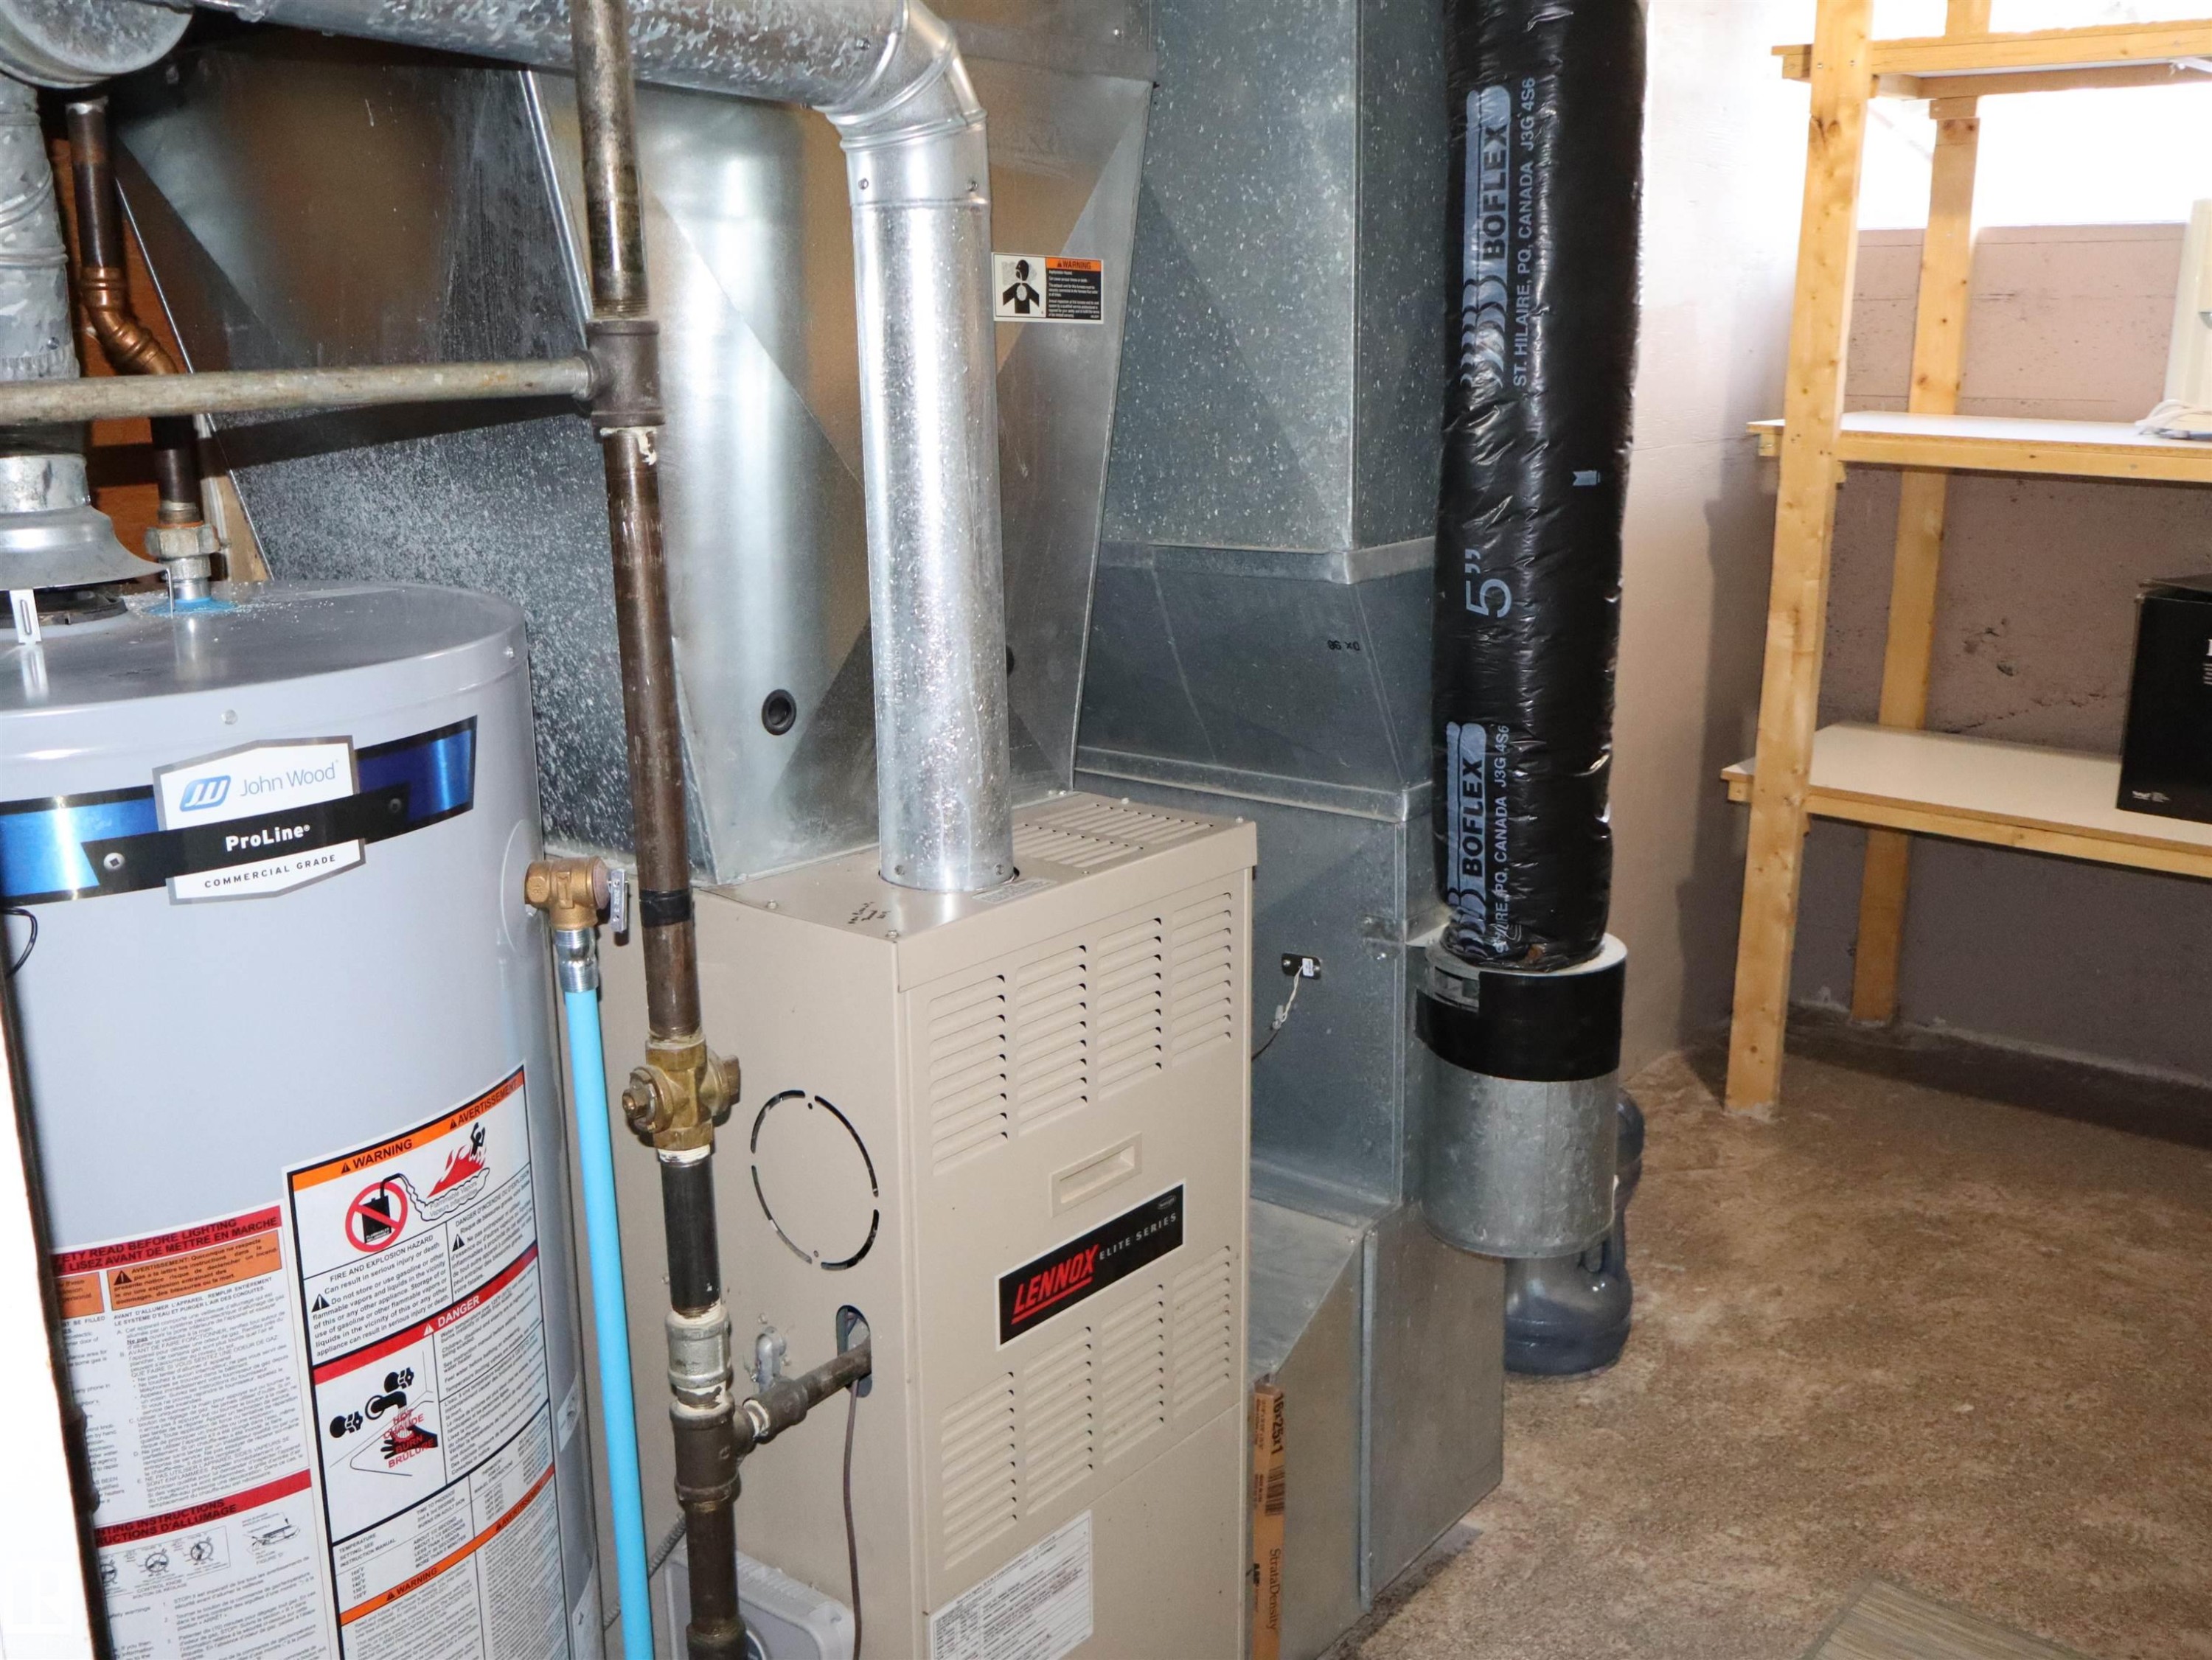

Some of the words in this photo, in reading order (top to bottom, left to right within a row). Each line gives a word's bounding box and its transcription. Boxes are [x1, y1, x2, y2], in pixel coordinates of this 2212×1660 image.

[1520, 77, 1535, 112] 4S6
[1520, 117, 1534, 150] J3G
[1481, 124, 1508, 261] BOFLEX
[1518, 161, 1533, 239] CANADA
[1062, 260, 1091, 270] WARNING
[1517, 243, 1531, 274] PQ,
[1514, 280, 1531, 355] HILAIRE,
[1513, 362, 1528, 387] ST.
[1495, 725, 1509, 752] 4S6
[240, 773, 282, 797] John
[287, 762, 335, 786] Wood
[1494, 758, 1506, 787] J3G
[1463, 756, 1483, 878] BOFLEX
[1495, 797, 1507, 862] CANADA
[204, 865, 291, 888] COMMERCIAL
[296, 854, 337, 870] GRADE
[352, 1138, 413, 1170] WARNING
[457, 1078, 518, 1126] AVERTISSEMENT
[69, 1258, 102, 1273] LISEZ
[105, 1250, 142, 1266] AVANT
[146, 1246, 162, 1258] DE
[168, 1235, 210, 1253] METTRE
[215, 1230, 228, 1241] EN
[231, 1217, 278, 1238] MARCHE
[89, 1244, 124, 1260] READ
[128, 1232, 178, 1252] BEFORE
[181, 1218, 236, 1239] LIGHTING
[330, 1272, 347, 1283] FIRE
[349, 1264, 364, 1276] AND
[366, 1246, 406, 1269] EXPLOSION
[407, 1235, 433, 1252] HAZARD
[324, 1286, 339, 1296] Can
[341, 1276, 361, 1289] result
[371, 1263, 395, 1277] serious
[397, 1254, 414, 1266] injury
[423, 1241, 439, 1254] death
[343, 1291, 354, 1301] not
[356, 1285, 372, 1296] store
[383, 1275, 394, 1284] use
[396, 1263, 421, 1280] gasoline
[430, 1252, 444, 1263] other
[1014, 1244, 1099, 1315] LENNOX
[1099, 1237, 1131, 1260] ELITE
[1135, 1213, 1176, 1241] SERIES
[180, 1301, 204, 1312] PURGER
[313, 1304, 348, 1321] flammable
[350, 1294, 372, 1307] vapors
[374, 1287, 386, 1297] and
[387, 1278, 407, 1291] liquids
[416, 1270, 425, 1278] the
[426, 1260, 445, 1274] vicinity
[315, 1330, 327, 1339] use
[337, 1316, 364, 1332] gasoline
[374, 1305, 390, 1316] other
[392, 1290, 421, 1308] flammable
[422, 1281, 440, 1294] vapors
[322, 1317, 335, 1327] this
[347, 1309, 358, 1318] any
[361, 1301, 377, 1312] other
[411, 1275, 433, 1290] Storage
[437, 1295, 481, 1328] DANGER
[114, 1311, 133, 1320] AVANT
[316, 1334, 340, 1348] liquids
[352, 1326, 362, 1334] the
[364, 1314, 389, 1329] vicinity
[399, 1304, 411, 1314] this
[420, 1294, 431, 1303] any
[433, 1286, 448, 1297] other
[317, 1340, 348, 1357] appliance
[349, 1335, 361, 1344] can
[363, 1326, 379, 1339] result
[389, 1314, 409, 1327] serious
[411, 1305, 426, 1317] injury
[396, 1434, 422, 1453] BURN
[1271, 1391, 1284, 1455] 16x25x1
[137, 1498, 224, 1529] INSTRUCTIONS
[161, 1503, 237, 1532] D'ALLUMAGE
[396, 1567, 437, 1595] WARNING
[1266, 1548, 1281, 1631] StrataDensity
